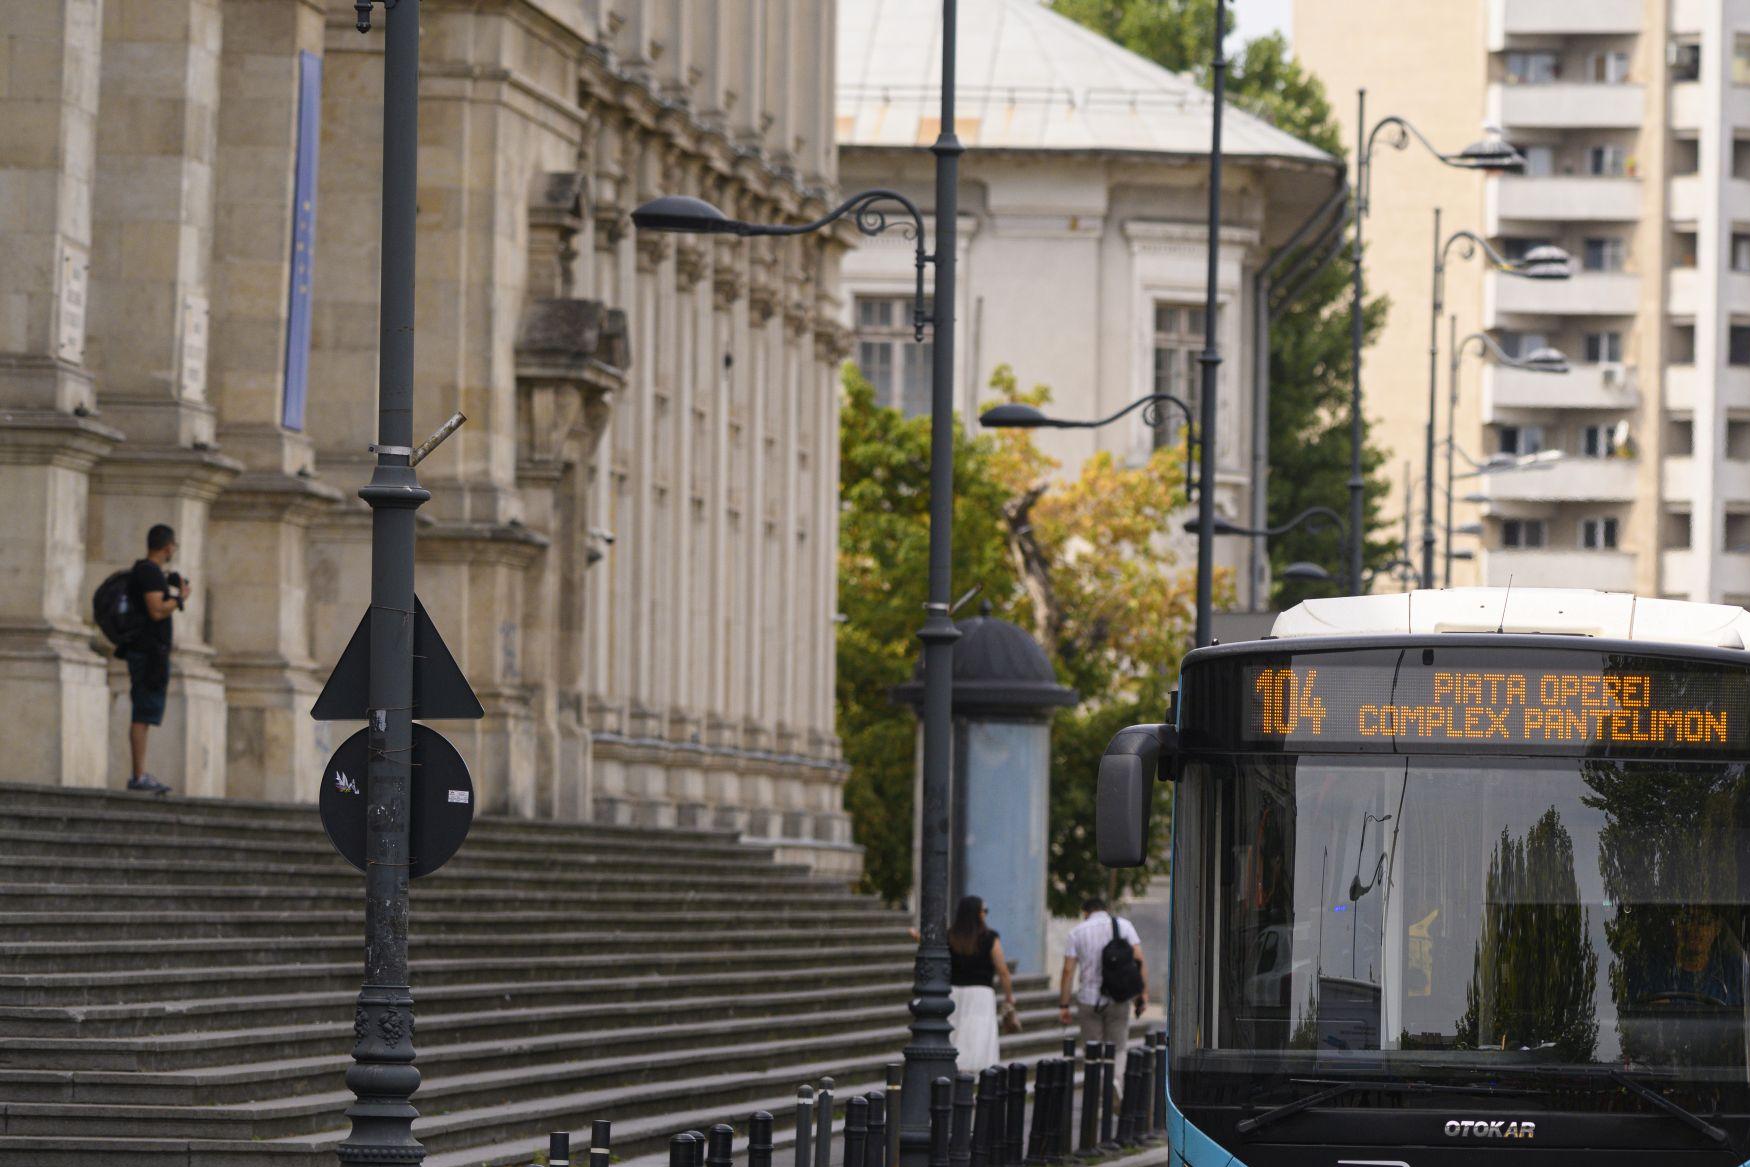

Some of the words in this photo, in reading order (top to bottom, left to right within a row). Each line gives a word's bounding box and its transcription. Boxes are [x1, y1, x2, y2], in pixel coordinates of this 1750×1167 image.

[1256, 669, 1326, 735] 104
[1434, 672, 1526, 705] PIATA
[1540, 674, 1650, 707] OPEREI
[1359, 704, 1510, 738] COMPLEX
[1524, 707, 1727, 742] PANTELIMON
[1444, 1120, 1536, 1139] OTOKAR
